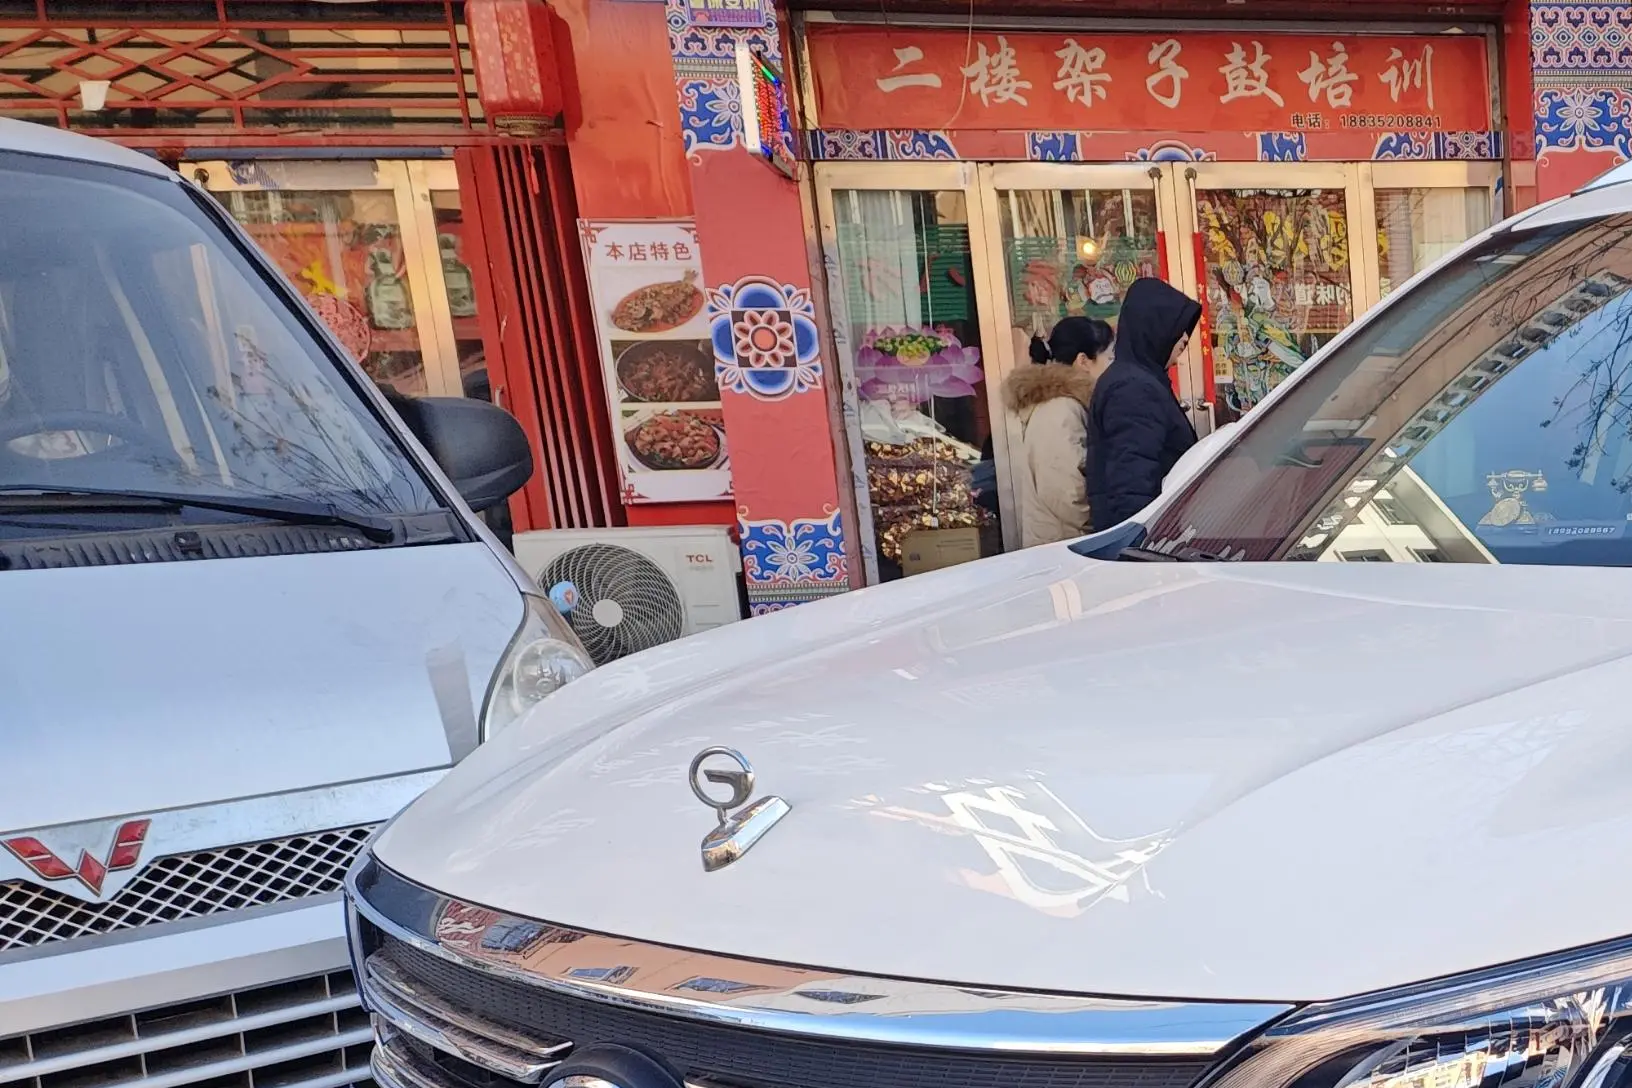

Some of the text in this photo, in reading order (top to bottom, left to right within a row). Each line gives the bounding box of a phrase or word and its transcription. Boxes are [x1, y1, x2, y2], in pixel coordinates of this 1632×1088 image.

[876, 36, 1434, 109] 二楼架子鼓培训
[1340, 114, 1441, 128] 18835208841
[604, 241, 692, 261] 本店特色
[685, 554, 713, 563] TCL
